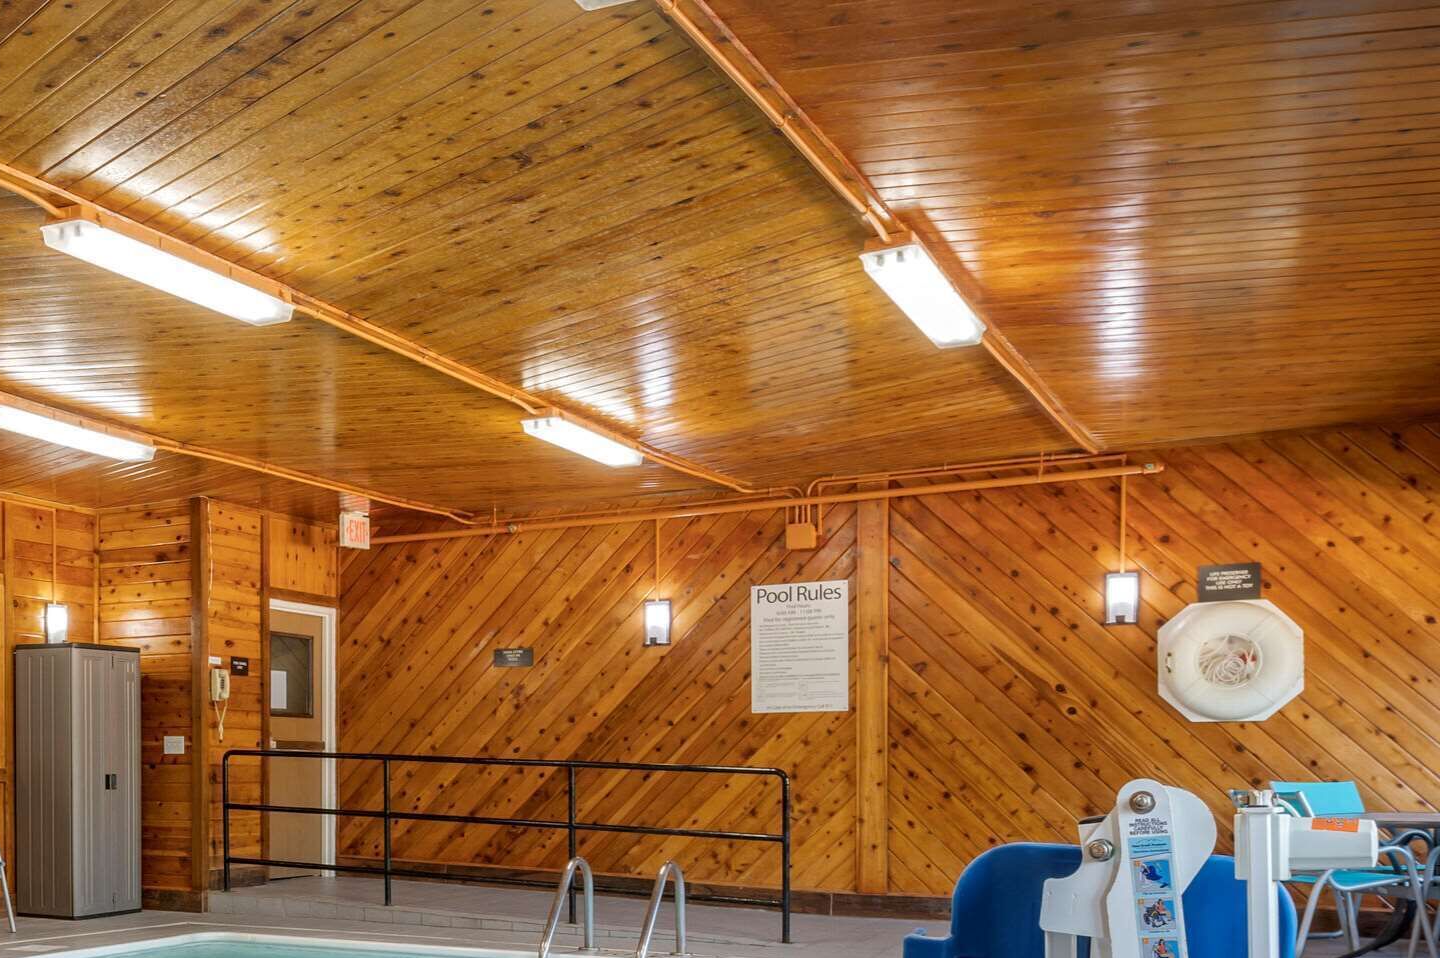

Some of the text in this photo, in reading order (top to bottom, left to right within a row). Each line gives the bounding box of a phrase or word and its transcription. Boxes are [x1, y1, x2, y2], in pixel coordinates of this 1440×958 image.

[349, 520, 367, 543] EXIT
[756, 584, 842, 604] Pool Rules
